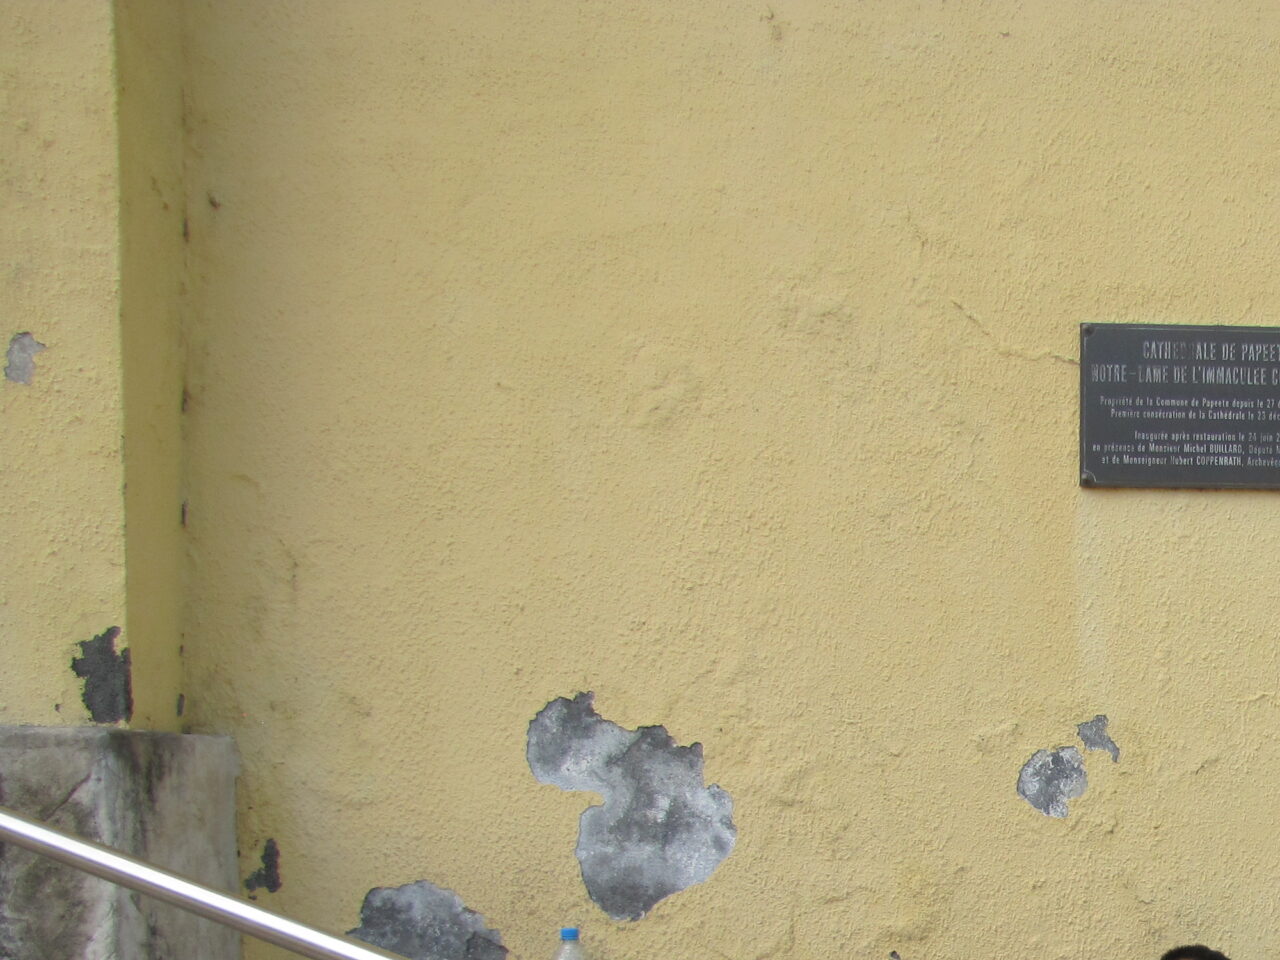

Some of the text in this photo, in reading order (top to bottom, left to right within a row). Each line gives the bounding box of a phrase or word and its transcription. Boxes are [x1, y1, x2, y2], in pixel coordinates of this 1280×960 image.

[1222, 343, 1235, 360] DE
[1173, 365, 1187, 383] DE
[1136, 397, 1143, 406] de
[1147, 397, 1153, 406] la
[1156, 397, 1188, 406] Commune
[1191, 398, 1199, 406] de
[1202, 398, 1229, 408] Papeete
[1232, 399, 1254, 409] depuis
[1257, 400, 1263, 408] le
[1267, 400, 1274, 408] 27
[1143, 409, 1186, 418] consécration
[1189, 410, 1196, 419] de
[1199, 410, 1205, 419] la
[1208, 410, 1245, 420] Cathédrale
[1248, 411, 1254, 420] le
[1257, 411, 1265, 420] 23
[1171, 431, 1190, 442] après
[1193, 432, 1236, 441] restauration
[1239, 432, 1245, 441] le
[1260, 433, 1273, 443] juin
[1137, 444, 1145, 452] de
[1183, 444, 1206, 453] Michel
[1248, 445, 1273, 456] Député
[1101, 456, 1109, 464] et
[1112, 455, 1120, 464] de
[1123, 455, 1167, 466] Monseigneur
[1170, 456, 1193, 465] Hubert
